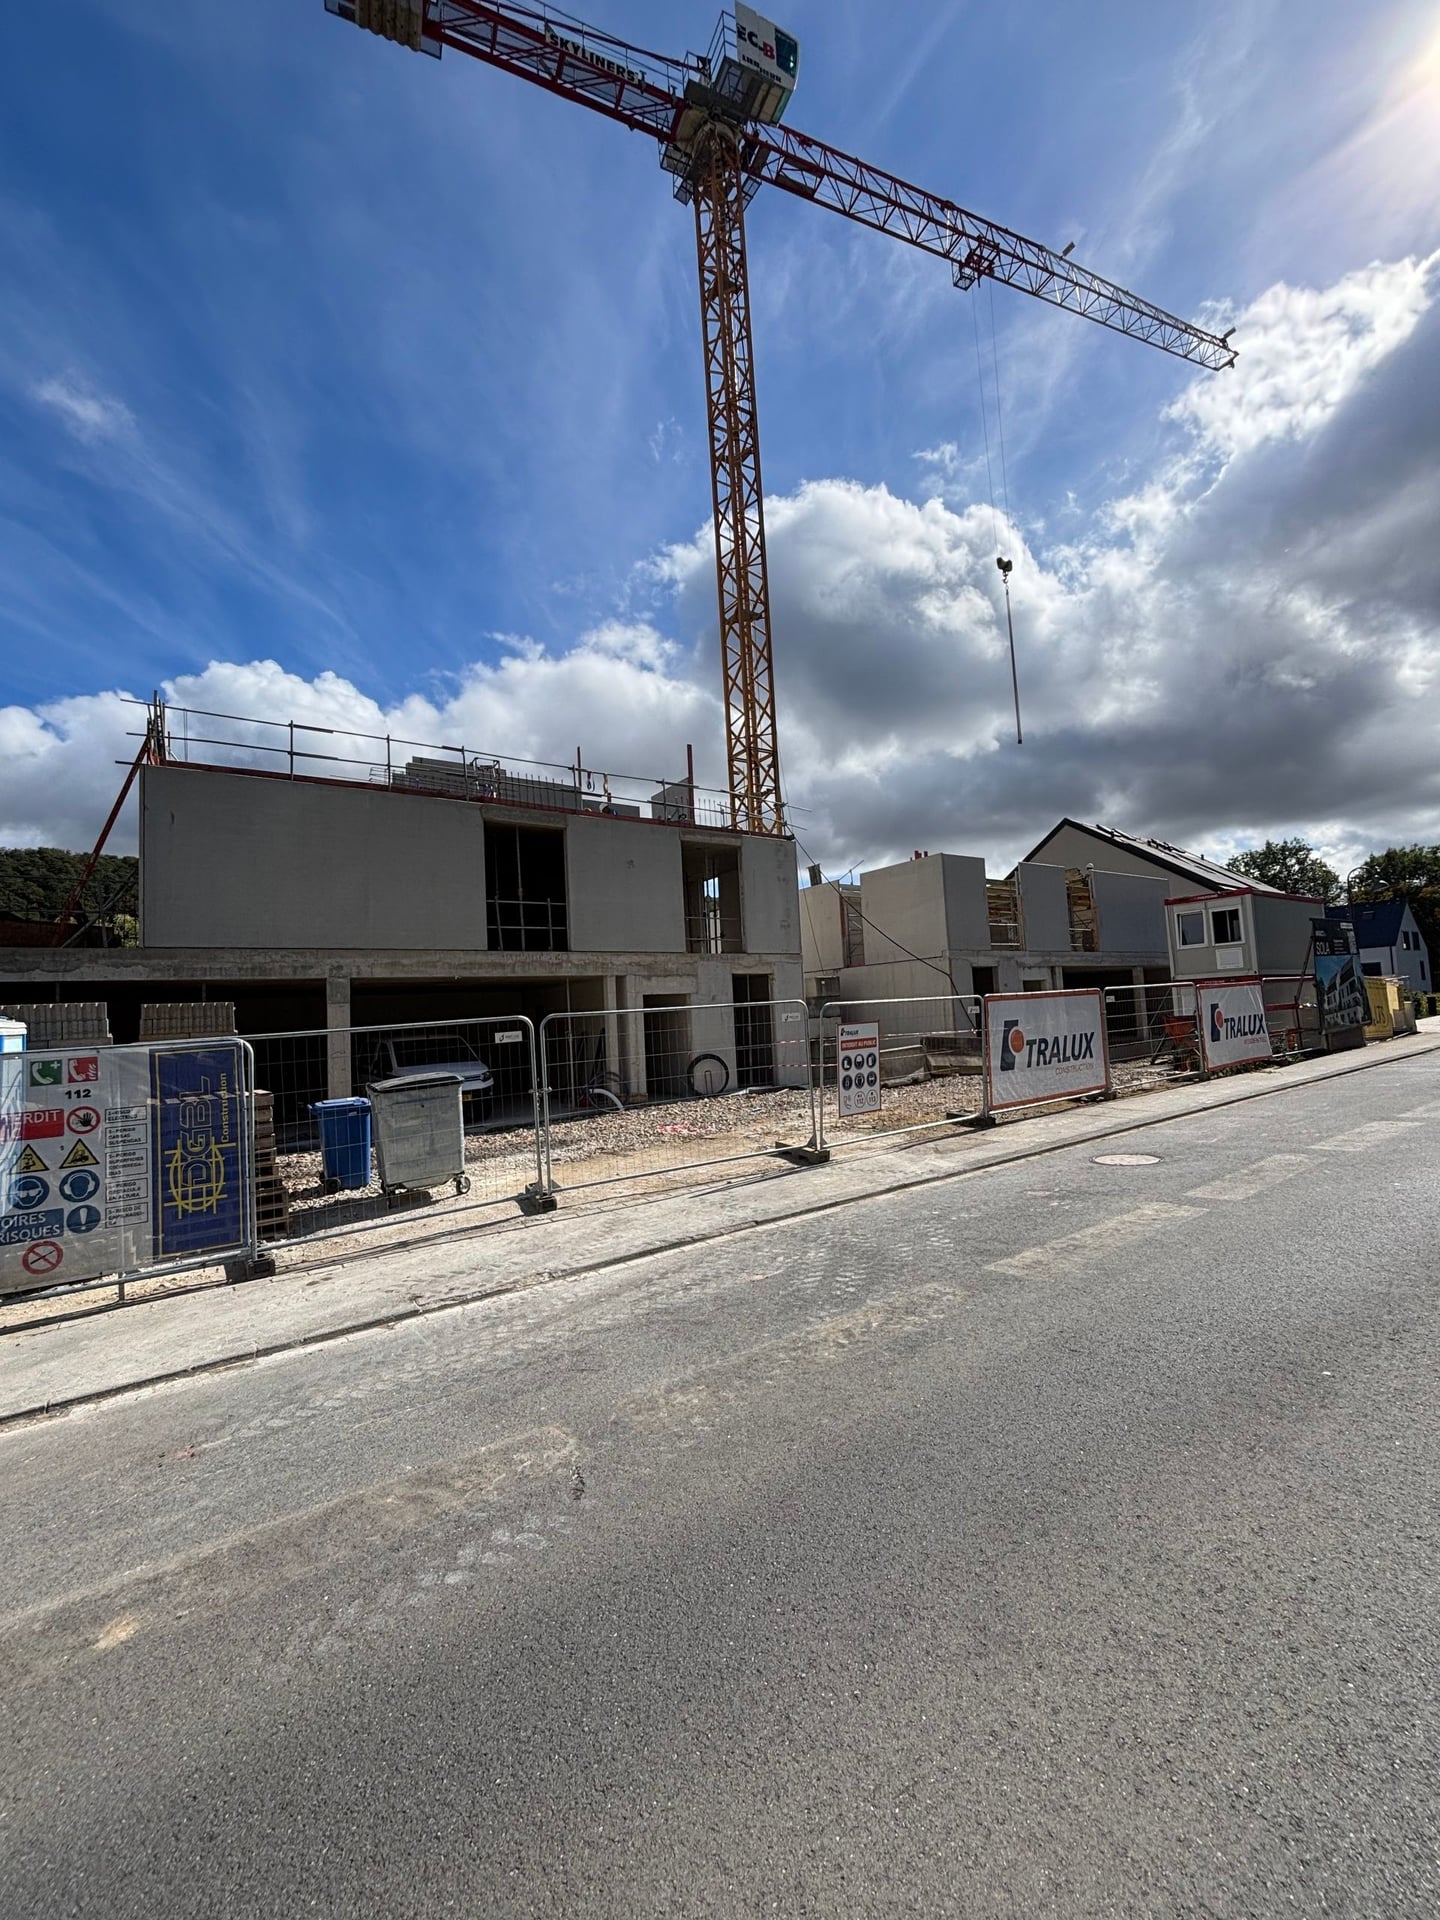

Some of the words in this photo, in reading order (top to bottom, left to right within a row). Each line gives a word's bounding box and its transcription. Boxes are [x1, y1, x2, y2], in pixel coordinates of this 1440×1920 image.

[549, 34, 636, 82] SKYLINERS
[1223, 1013, 1266, 1041] TRALUX
[1026, 1031, 1095, 1068] TRALUX
[65, 1088, 92, 1100] 112
[1, 1212, 47, 1229] OIRES
